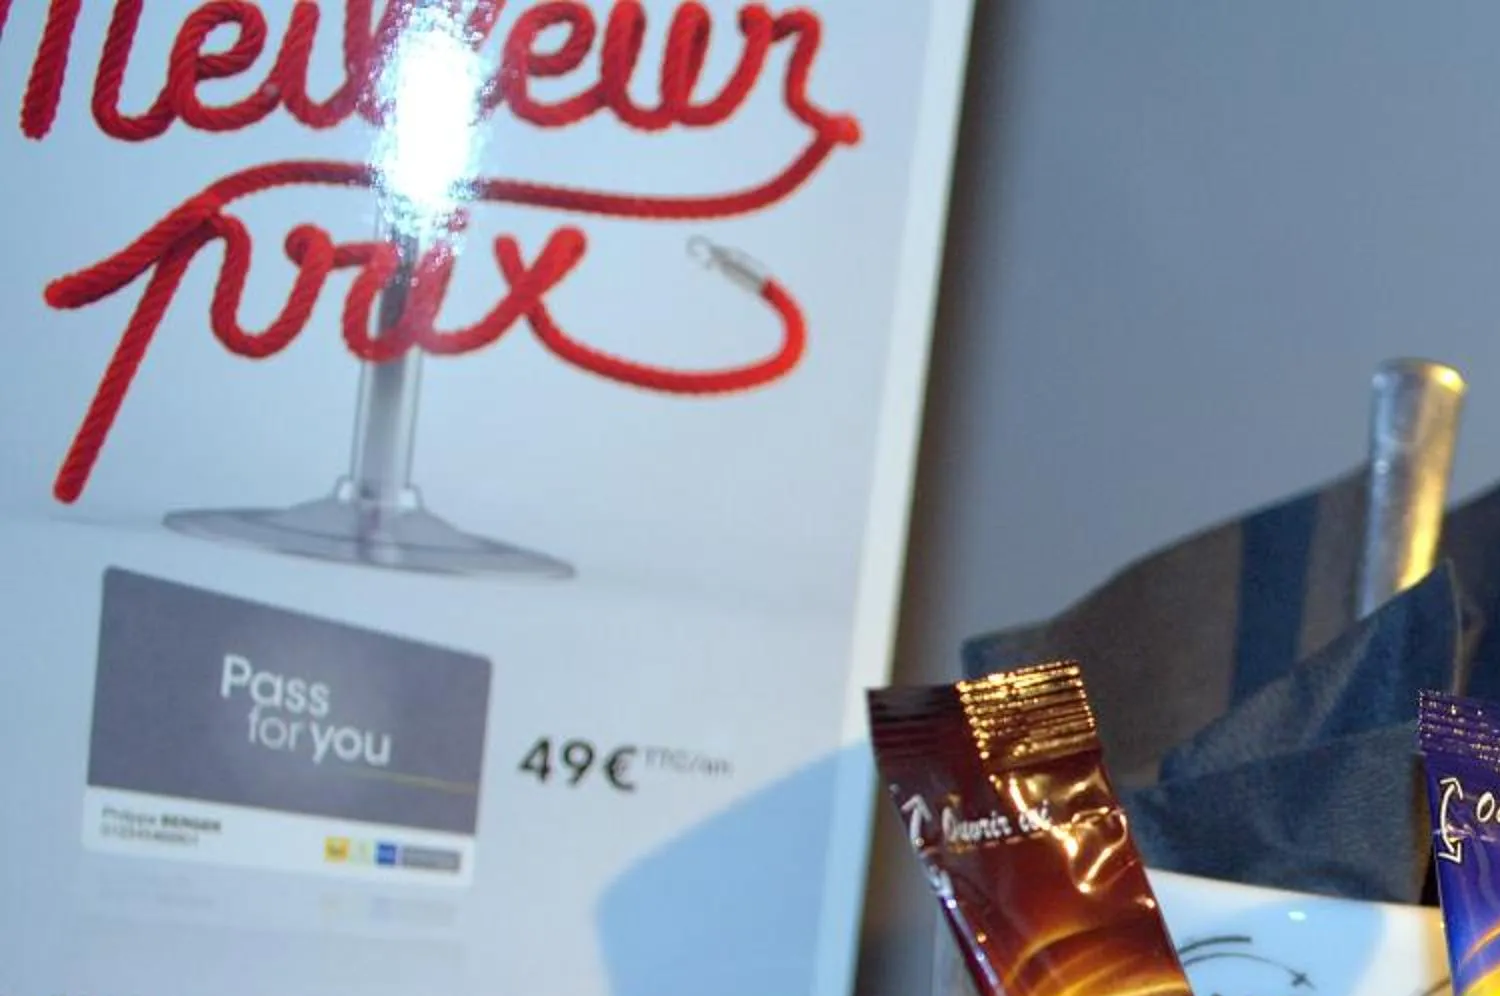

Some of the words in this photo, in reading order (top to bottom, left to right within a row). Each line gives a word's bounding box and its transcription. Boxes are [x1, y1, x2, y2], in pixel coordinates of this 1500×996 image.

[220, 654, 330, 718] Pass
[247, 704, 304, 753] for
[310, 721, 393, 767] you
